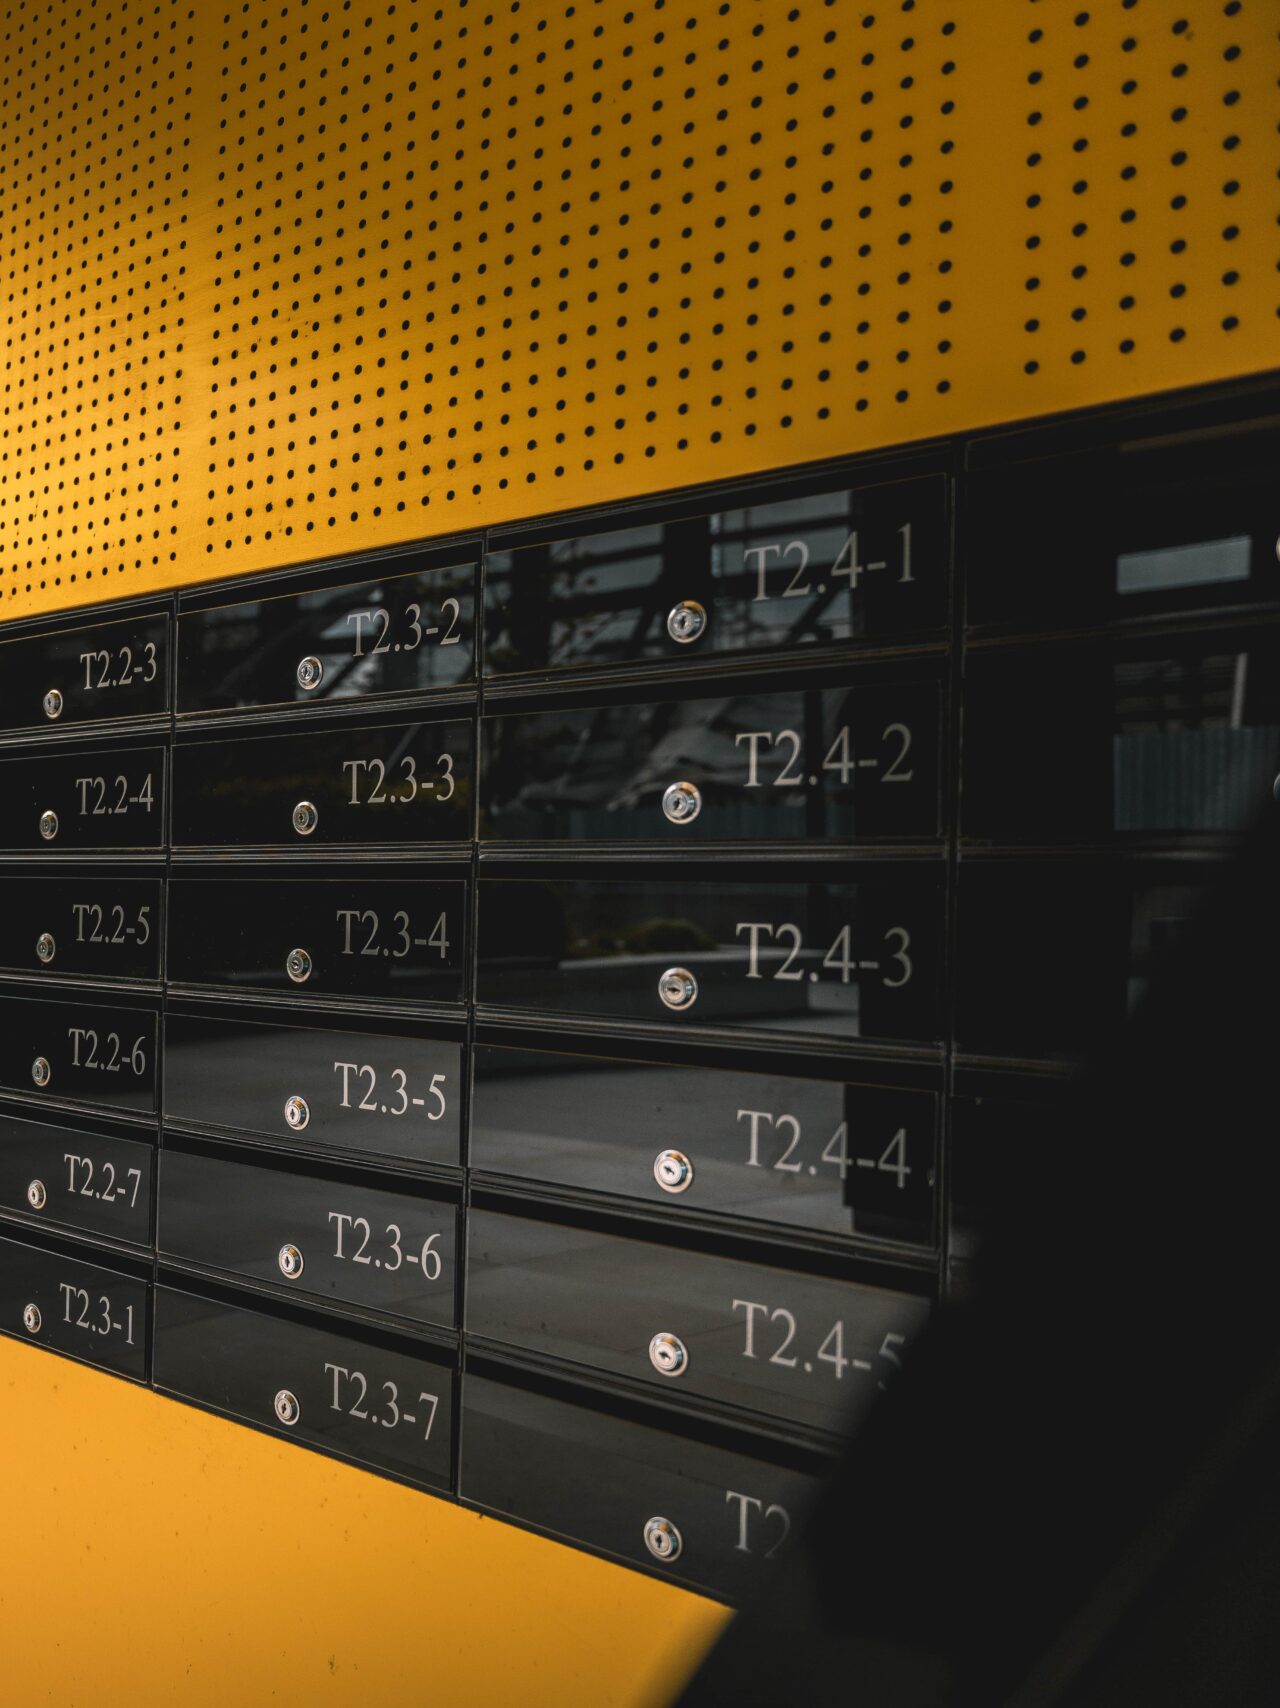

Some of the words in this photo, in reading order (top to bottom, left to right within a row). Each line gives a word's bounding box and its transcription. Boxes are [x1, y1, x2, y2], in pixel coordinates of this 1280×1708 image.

[743, 522, 916, 601] T2.4-1
[347, 598, 462, 658] T2.3-2
[80, 642, 157, 690] T2.2-3
[343, 753, 456, 805] T2.3-3
[735, 723, 914, 788] T2.4-2
[76, 773, 154, 815] T2.2-4
[73, 904, 151, 945] T2.2-5
[336, 910, 450, 959] T2.3-4
[735, 922, 913, 988] T2.4-3
[68, 1028, 147, 1075] T2.2-6
[334, 1061, 447, 1121] T2.3-5
[736, 1109, 911, 1189] T2.4-4
[64, 1153, 142, 1208] T2.2-7
[328, 1212, 442, 1281] T2.3-6
[59, 1283, 135, 1346] T2.3-1
[324, 1363, 439, 1441] T2.3-7
